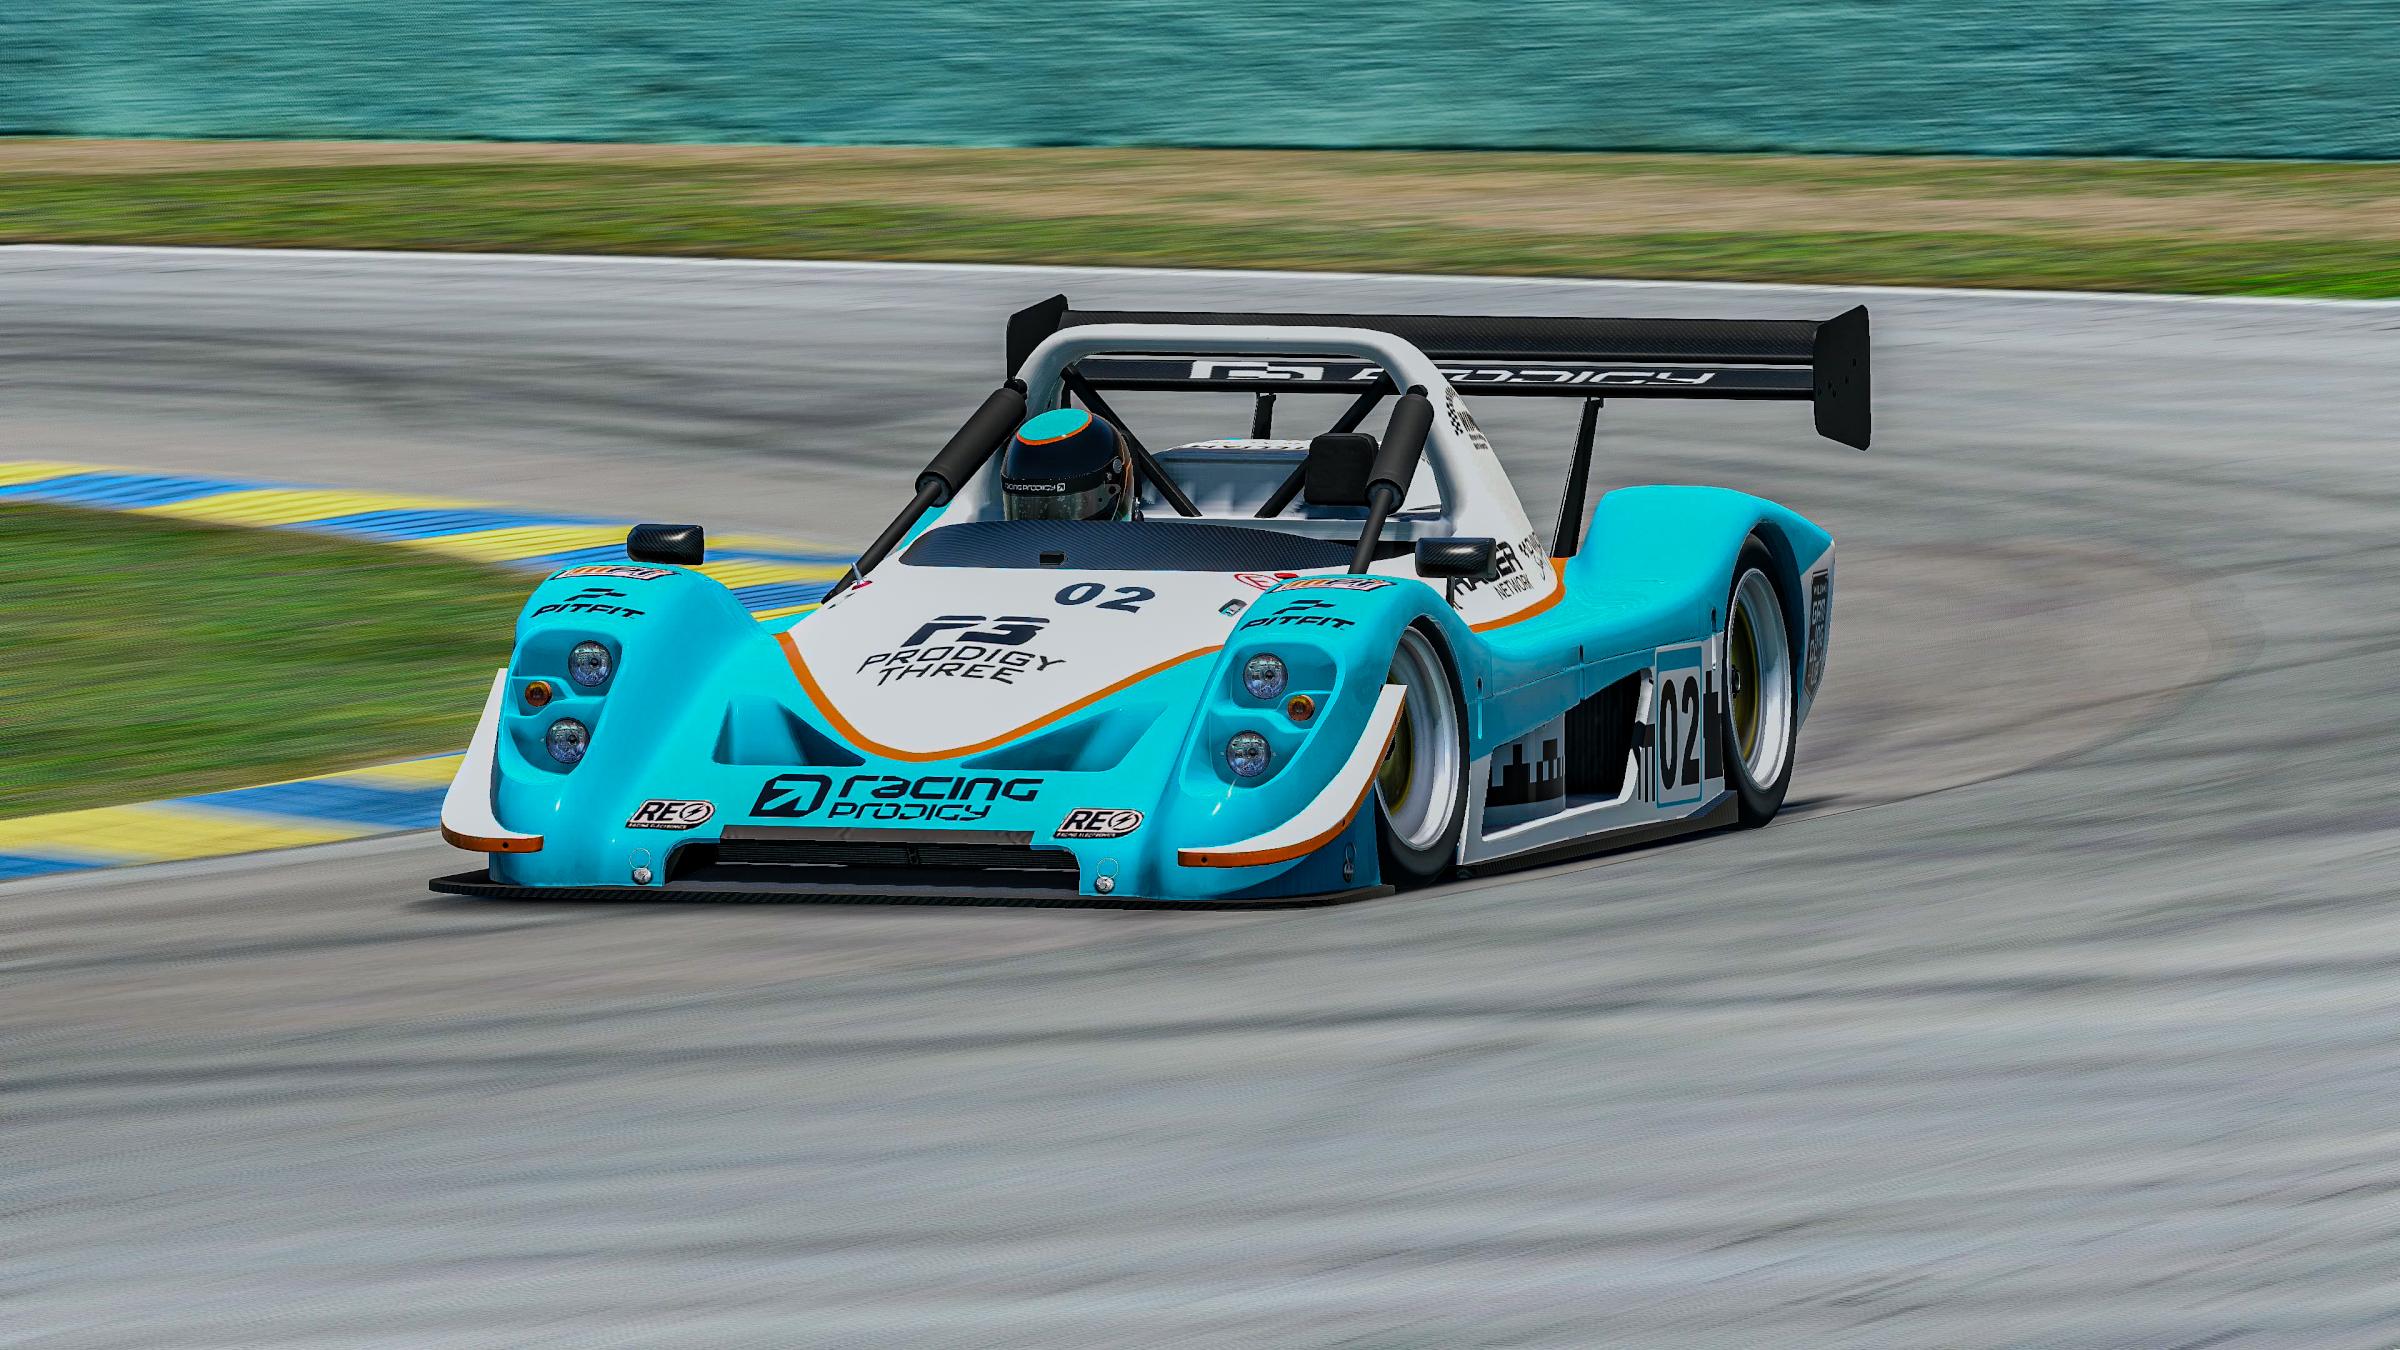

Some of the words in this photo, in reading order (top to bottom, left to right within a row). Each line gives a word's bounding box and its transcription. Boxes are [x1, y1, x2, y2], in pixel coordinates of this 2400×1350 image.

[530, 603, 646, 619] PITFIT
[1054, 582, 1156, 614] 02
[1239, 615, 1356, 631] PITFIT
[856, 645, 1067, 674] PRODIGY
[877, 662, 1025, 687] THREE
[1660, 675, 1700, 790] 02
